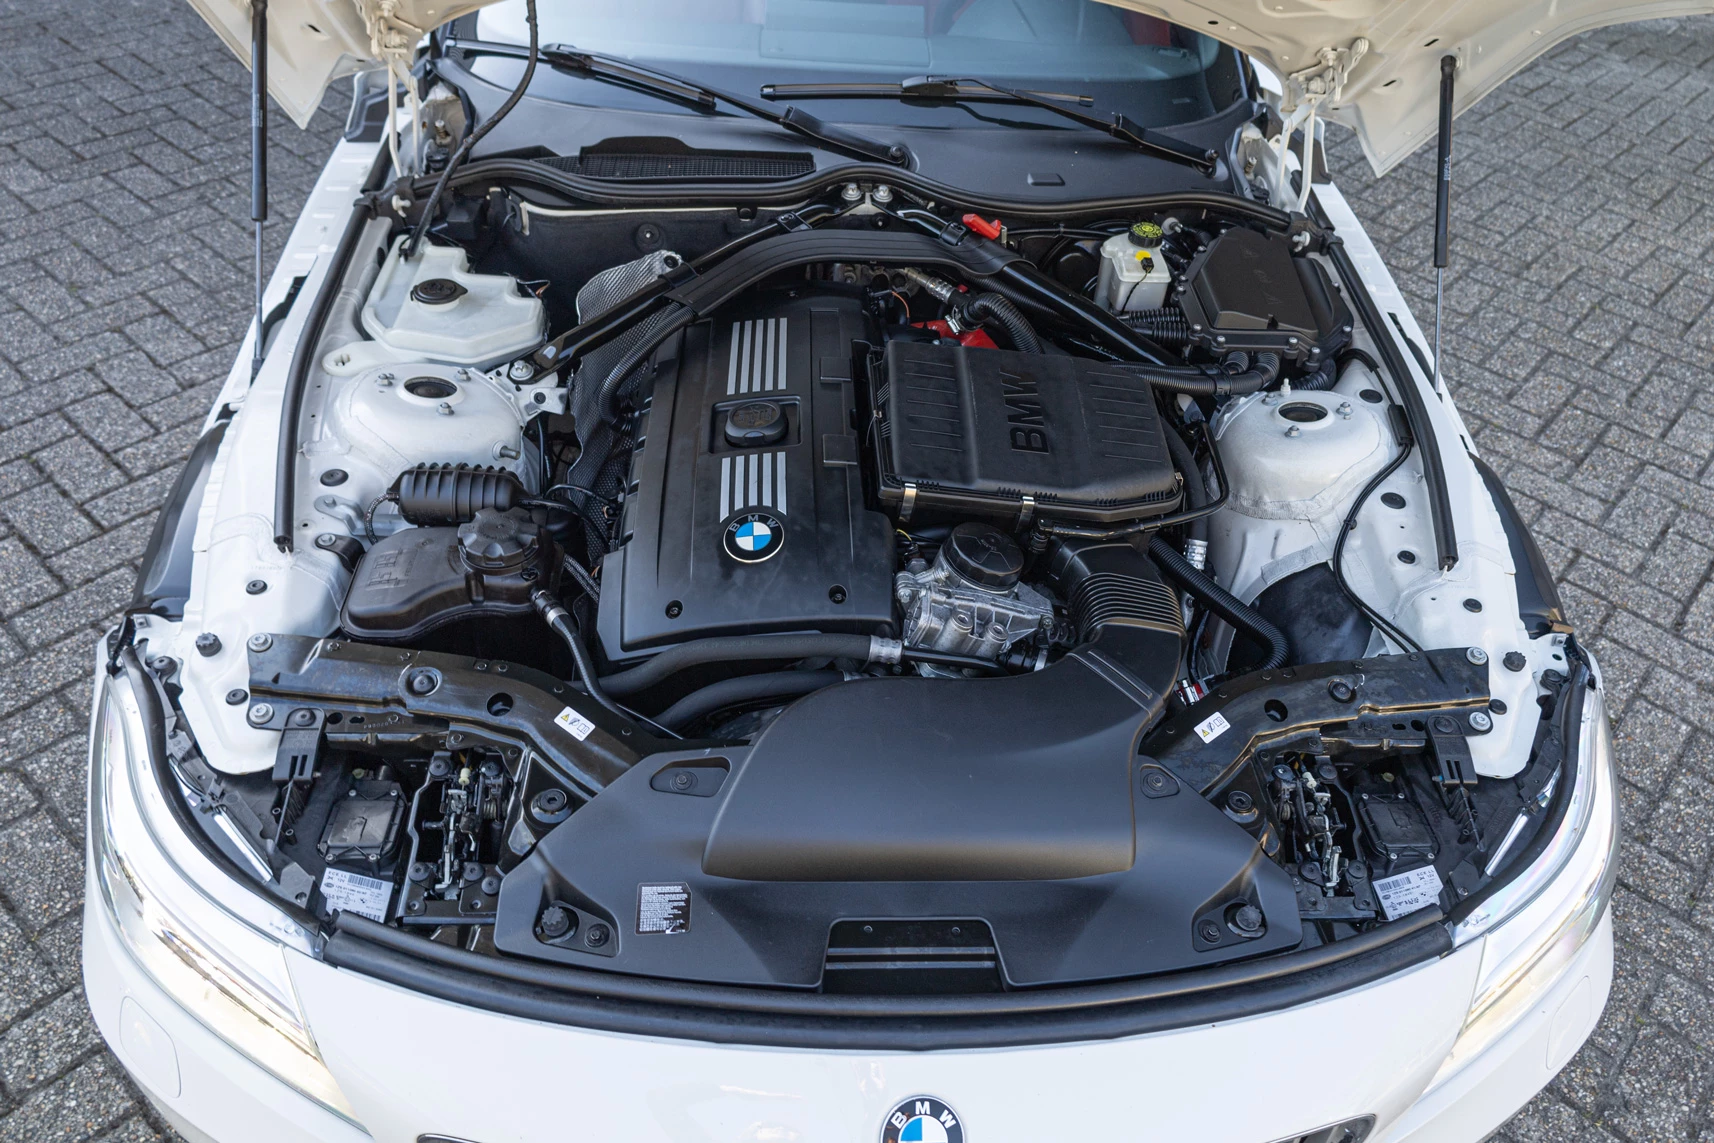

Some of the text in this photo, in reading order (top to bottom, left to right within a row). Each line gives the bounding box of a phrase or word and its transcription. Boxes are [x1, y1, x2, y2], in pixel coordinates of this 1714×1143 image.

[1000, 371, 1050, 454] BMW
[728, 514, 779, 532] BMW
[890, 1100, 957, 1129] BMW
